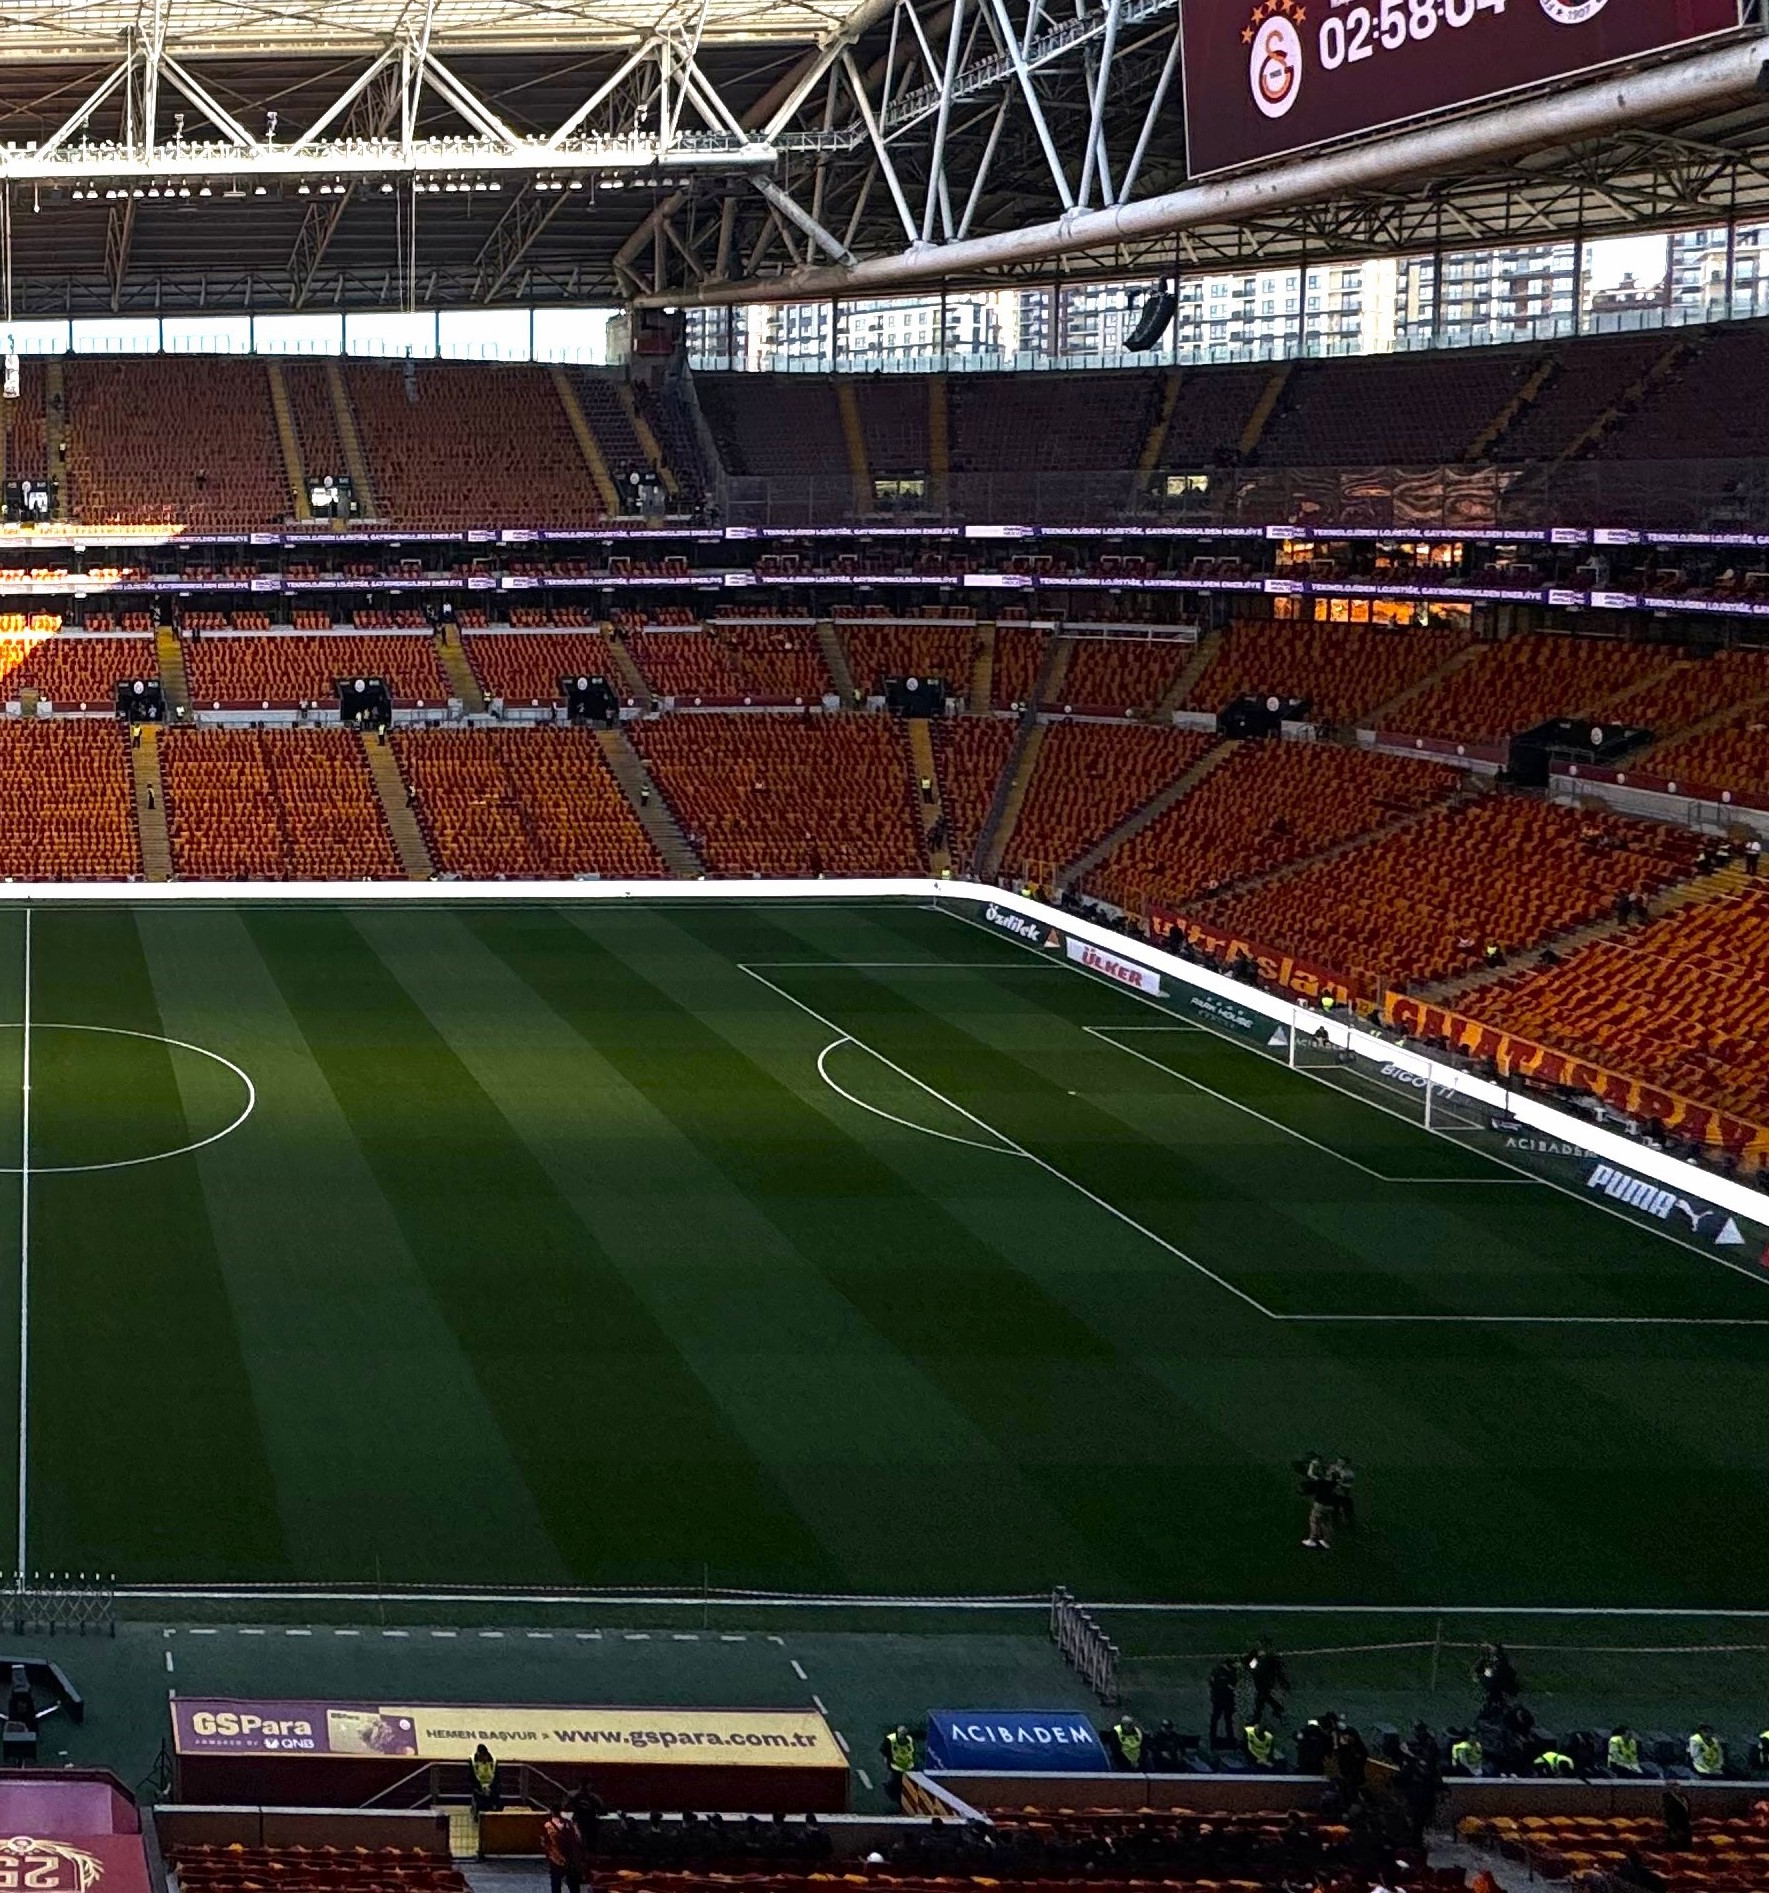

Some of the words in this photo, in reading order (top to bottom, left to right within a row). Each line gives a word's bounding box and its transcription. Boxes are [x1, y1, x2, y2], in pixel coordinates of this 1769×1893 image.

[985, 902, 1041, 943] Özdilek
[1082, 945, 1143, 988] ÜLKER
[1587, 1164, 1677, 1219] PUMA
[192, 1712, 313, 1736] GSPara
[952, 1724, 1093, 1743] ACIBADEM
[281, 1739, 315, 1749] QNB
[426, 1729, 478, 1740] HEMEN
[478, 1729, 538, 1743] BAŞVUR
[554, 1730, 818, 1748] www.gspara.com.tr
